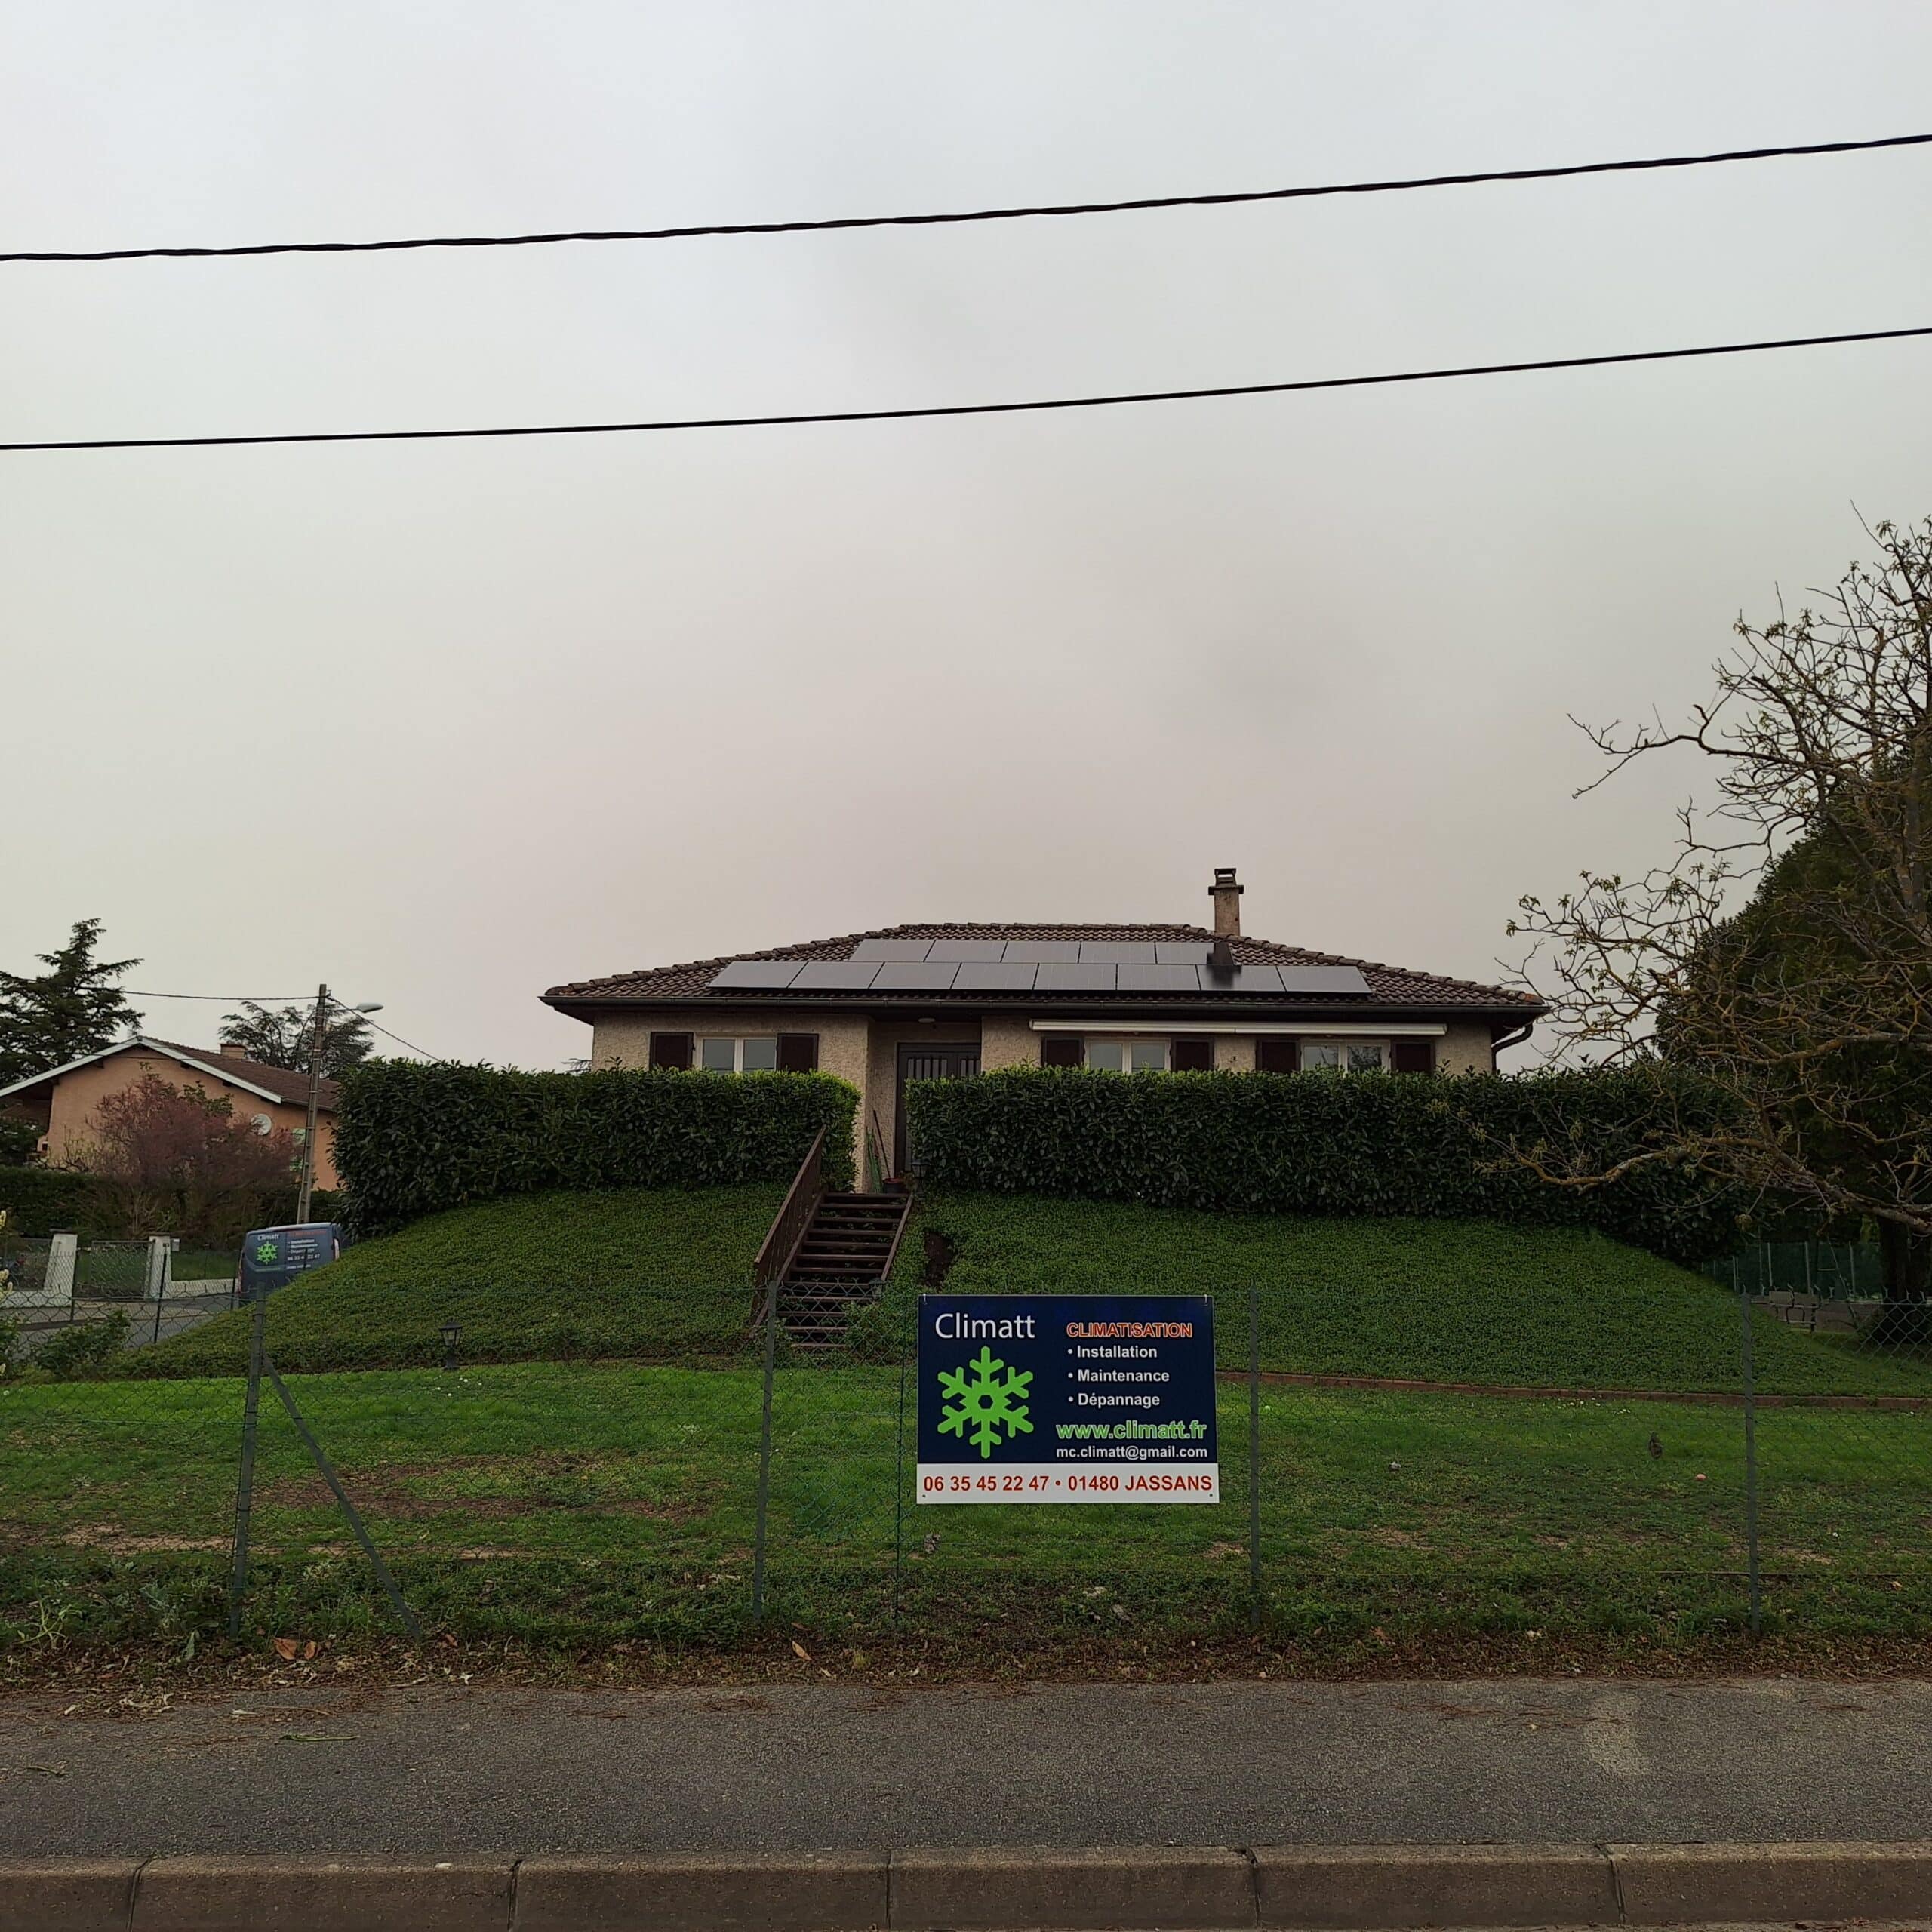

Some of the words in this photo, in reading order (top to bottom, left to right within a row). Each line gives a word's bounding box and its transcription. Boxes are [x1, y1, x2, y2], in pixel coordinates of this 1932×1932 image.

[934, 1312, 1036, 1339] Climatt
[1066, 1322, 1193, 1338] CLIMATISATION
[1077, 1345, 1158, 1358] Installation
[1078, 1368, 1170, 1382] Maintenance
[1078, 1392, 1161, 1409] Dépannage
[1055, 1420, 1208, 1439] www.climatt.fr
[1056, 1445, 1208, 1460] mc.climatt@gmail.com
[923, 1475, 944, 1492] 06
[950, 1475, 971, 1492] 35
[976, 1475, 997, 1492] 45
[1002, 1475, 1023, 1492] 22
[1029, 1475, 1050, 1492] 47
[1068, 1475, 1120, 1492] 01480
[1124, 1475, 1213, 1492] JASSANS
